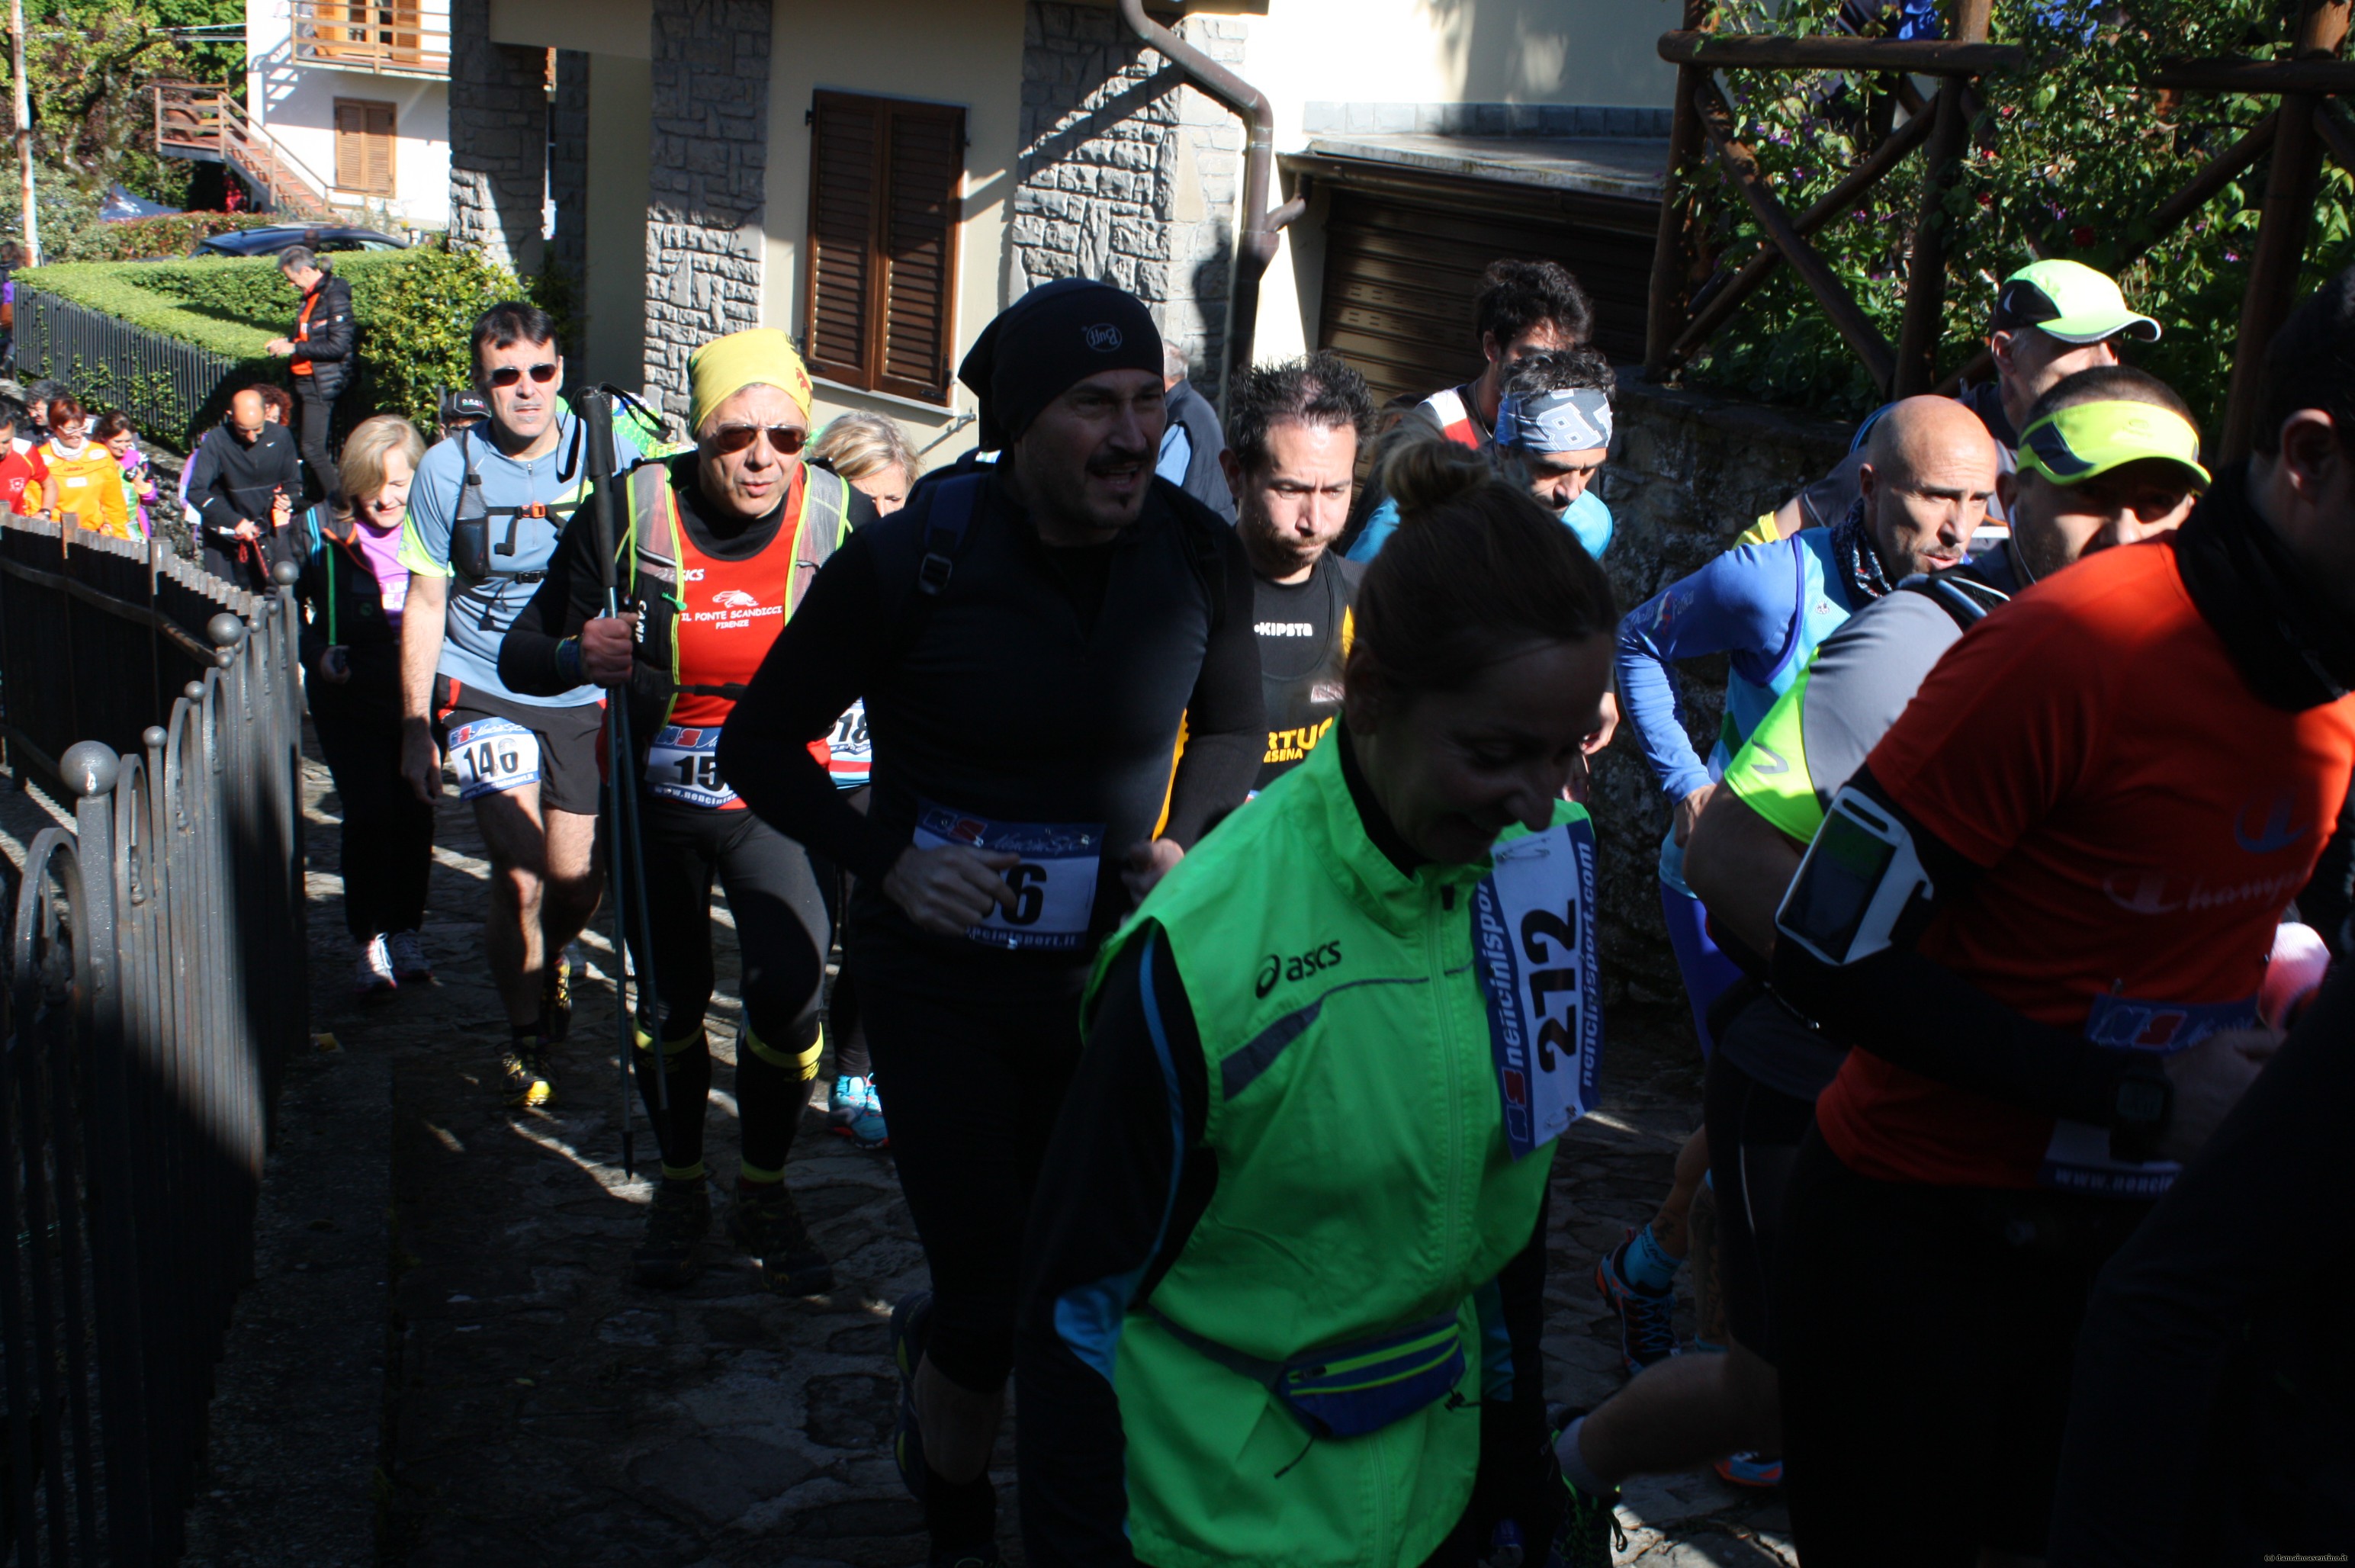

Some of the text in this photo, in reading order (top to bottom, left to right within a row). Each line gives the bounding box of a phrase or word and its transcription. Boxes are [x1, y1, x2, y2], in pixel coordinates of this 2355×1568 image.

[681, 606, 782, 622] IL PONTE SCANDICCI
[715, 619, 750, 630] FIRENZE
[463, 737, 519, 783] 146
[1286, 940, 1341, 982] asics
[1521, 898, 1576, 1073] 212
